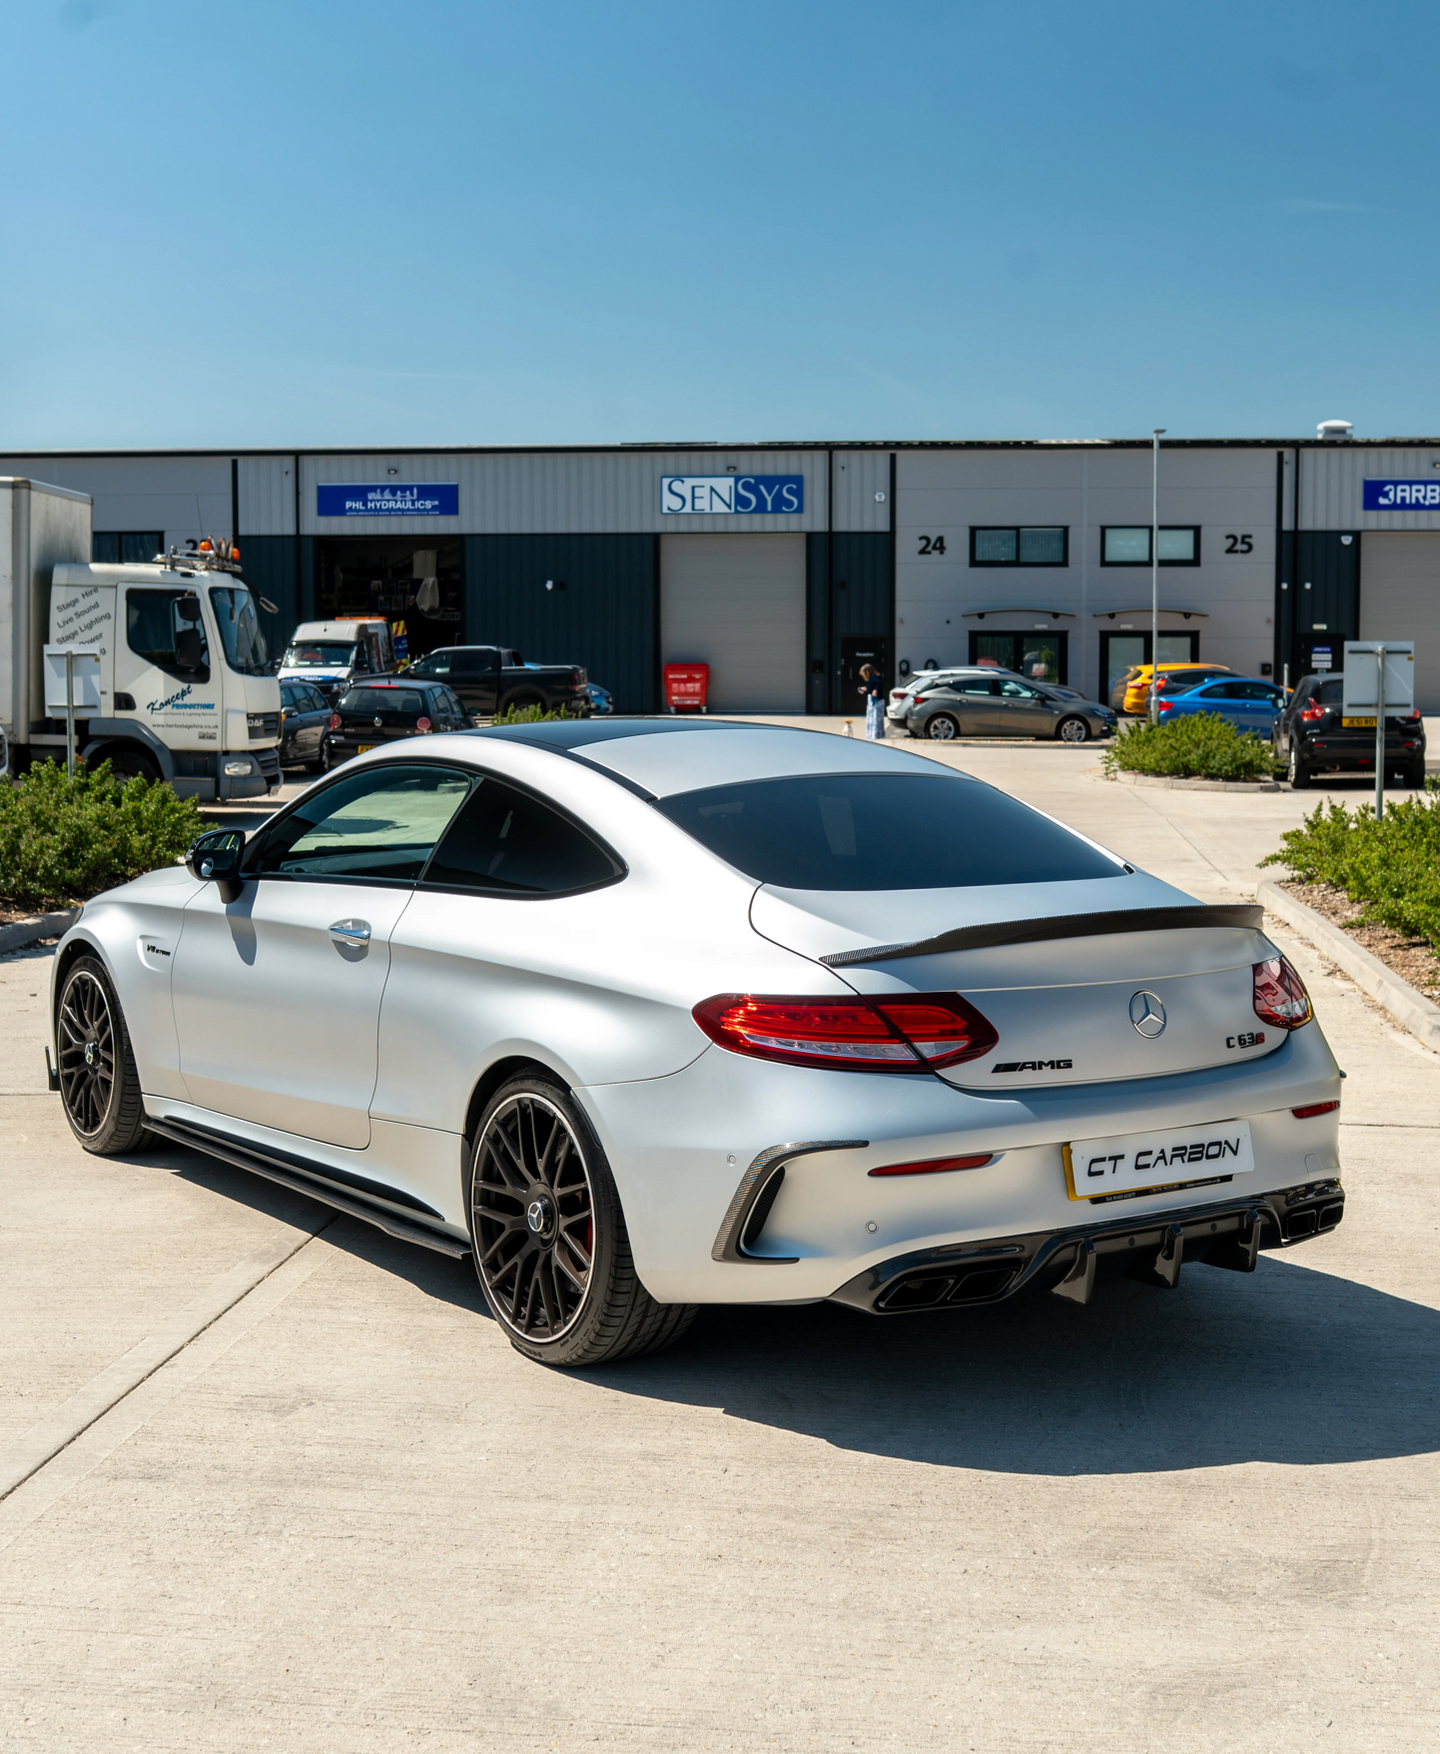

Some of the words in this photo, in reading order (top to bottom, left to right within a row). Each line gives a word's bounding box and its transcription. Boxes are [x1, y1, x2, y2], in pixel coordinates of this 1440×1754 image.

[345, 501, 366, 510] PHL
[367, 500, 432, 510] HYDRAULICS
[917, 535, 946, 555] 24
[1224, 534, 1254, 554] 25
[56, 597, 80, 613] Stage
[81, 586, 99, 600] Hire
[56, 616, 74, 629] Live
[74, 601, 100, 620] Sound
[56, 629, 79, 645] Stage
[78, 612, 112, 633] Lighting
[146, 684, 193, 715] Koncept
[247, 719, 264, 727] DAF
[1225, 1036, 1236, 1049] C
[1018, 1059, 1072, 1072] AMG
[1087, 1154, 1125, 1177] CT
[1134, 1138, 1240, 1170] CARBON
